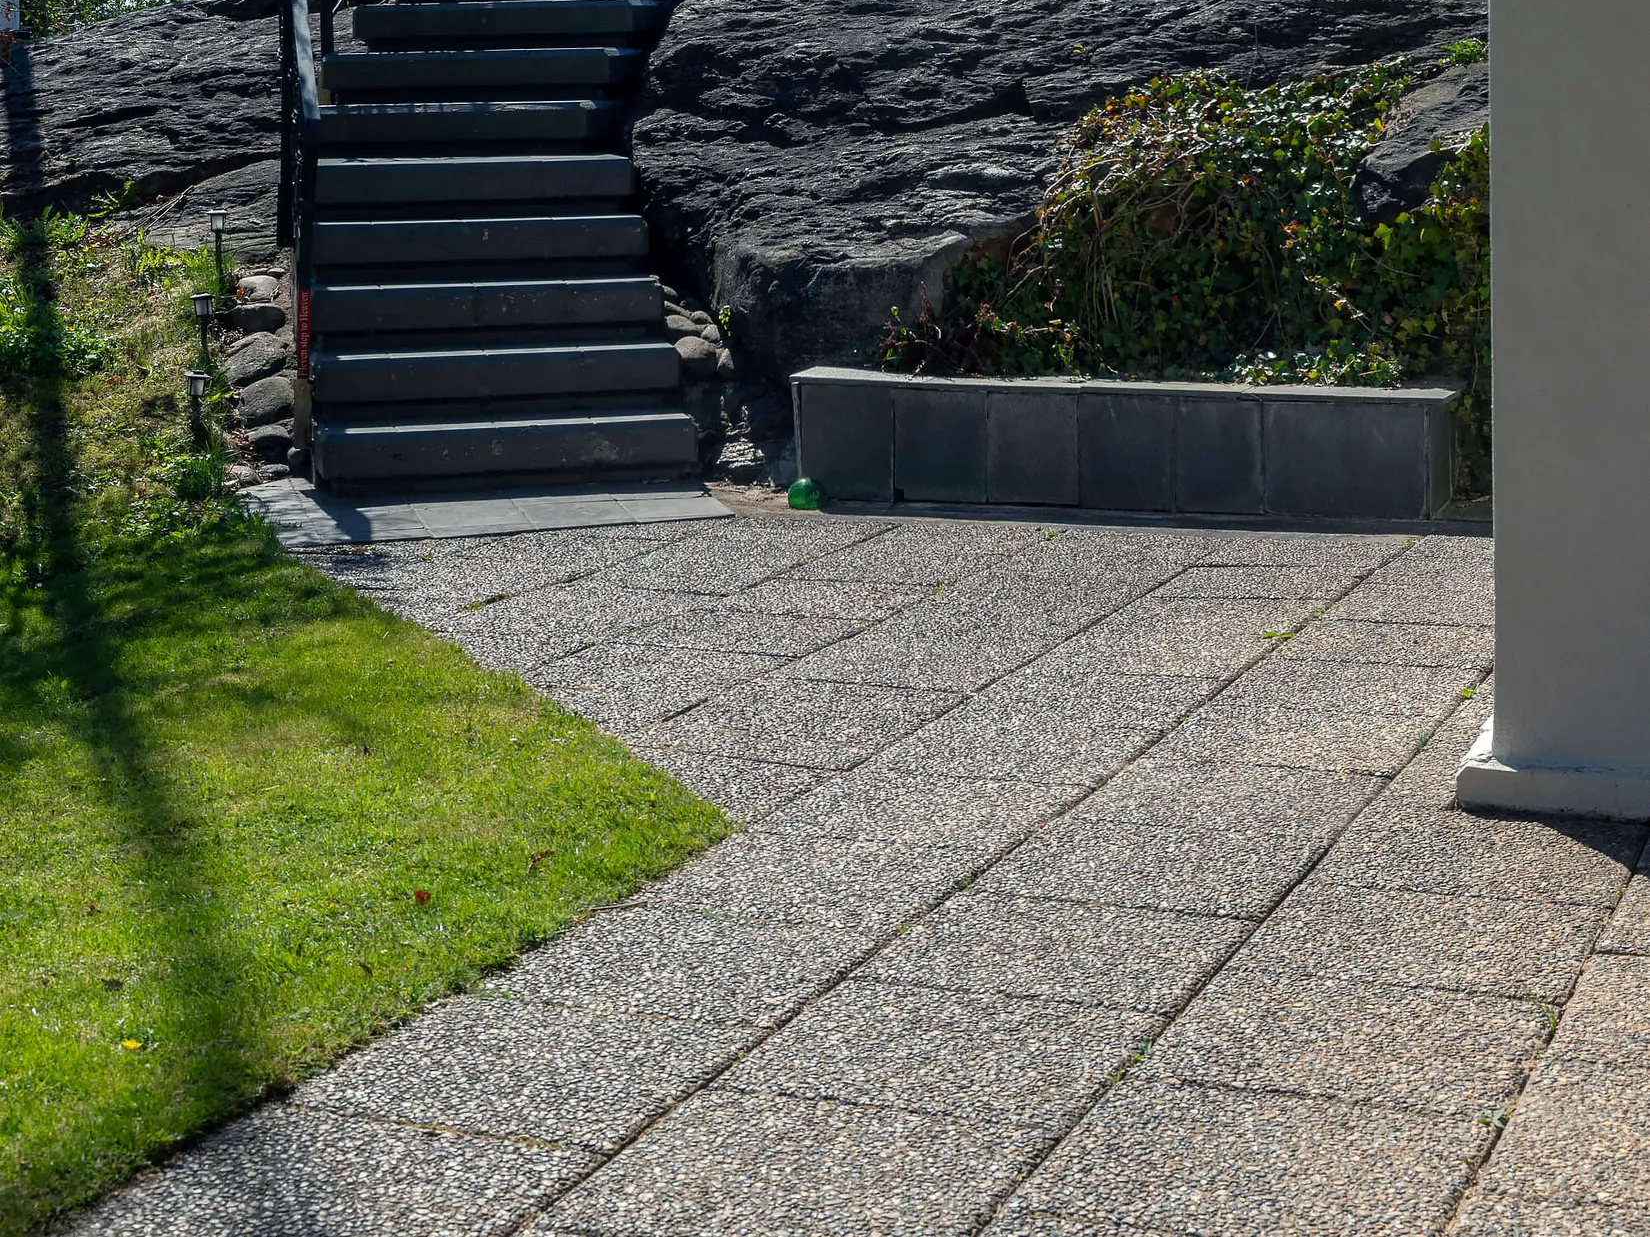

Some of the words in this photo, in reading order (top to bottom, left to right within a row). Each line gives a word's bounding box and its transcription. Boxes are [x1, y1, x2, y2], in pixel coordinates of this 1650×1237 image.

[299, 292, 308, 321] Heaven
[301, 322, 308, 331] to
[300, 332, 310, 349] step
[299, 349, 308, 376] Eleven
